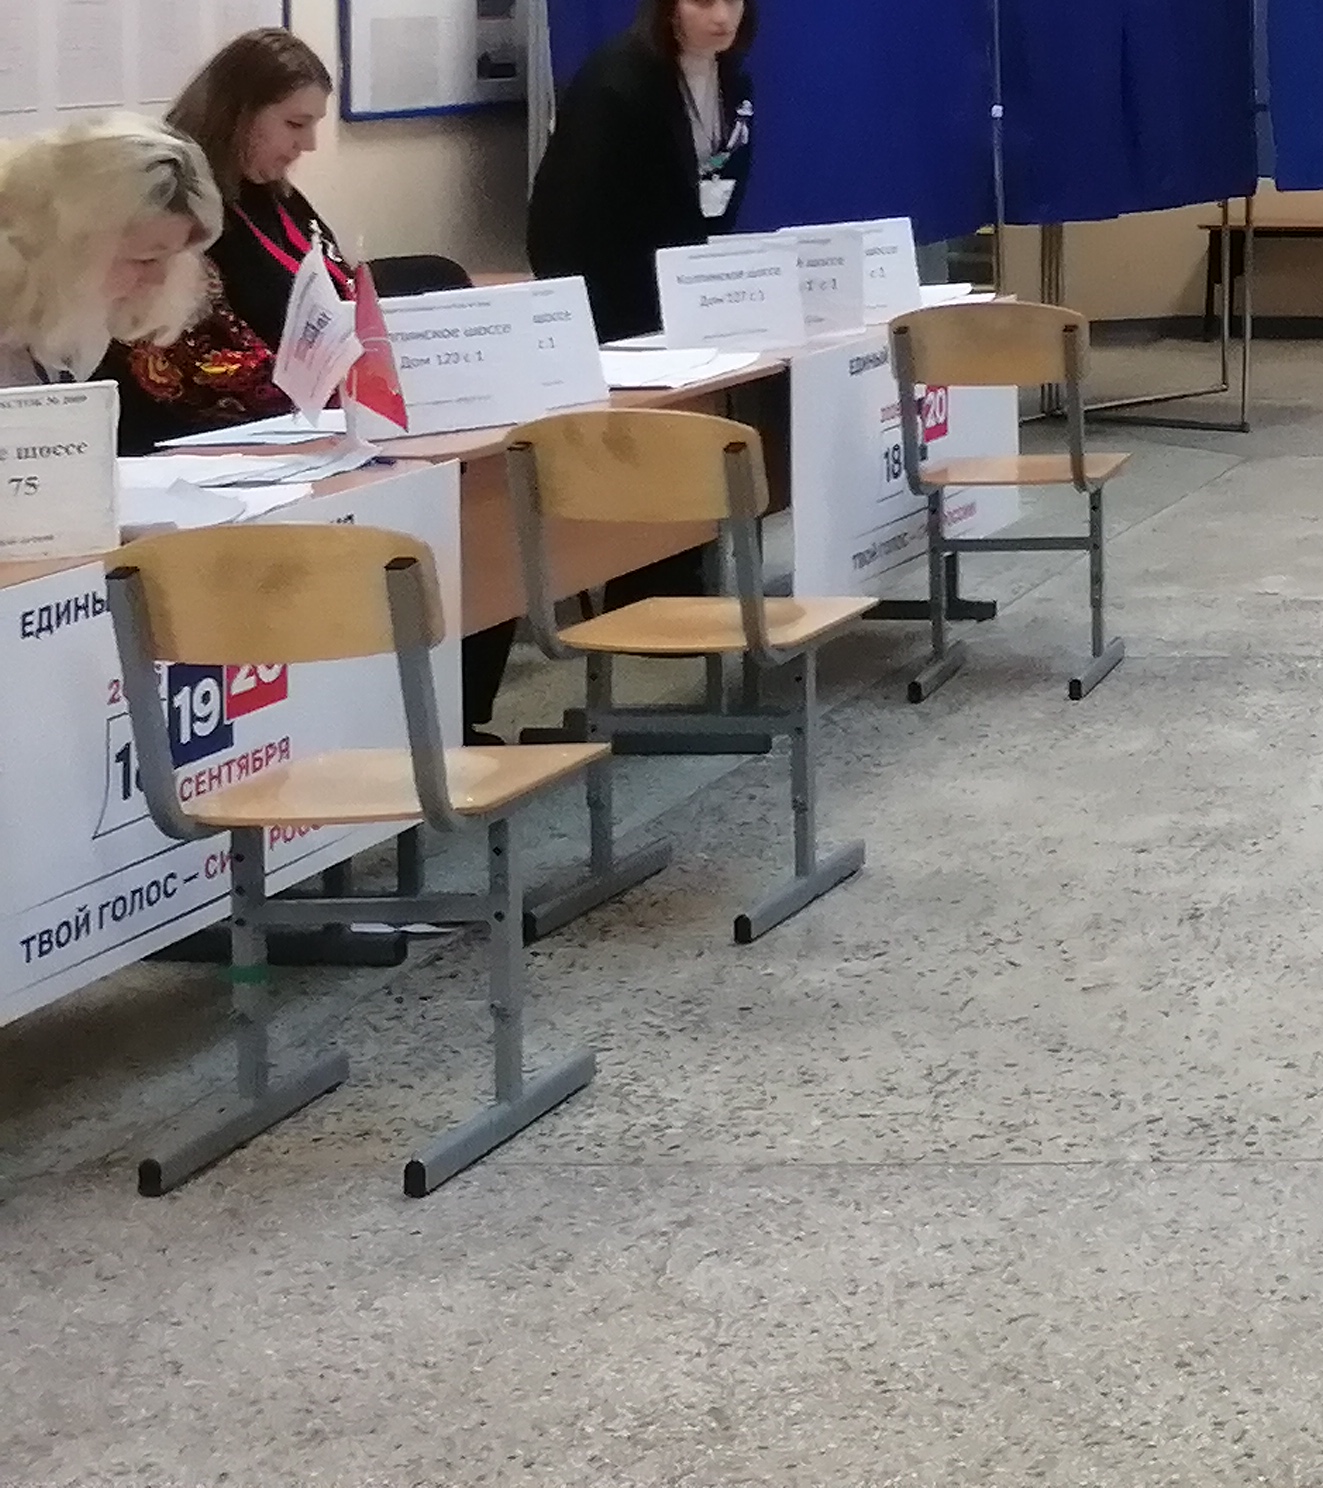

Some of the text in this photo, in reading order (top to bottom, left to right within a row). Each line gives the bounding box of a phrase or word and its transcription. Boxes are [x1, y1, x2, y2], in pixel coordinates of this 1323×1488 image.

[20, 591, 110, 640] ЕДИНЫ
[173, 676, 221, 745] 19
[178, 735, 291, 803] СЕНТЯБРЯ
[20, 907, 91, 964] ТВОЙ
[99, 870, 178, 930] ГОЛОС
